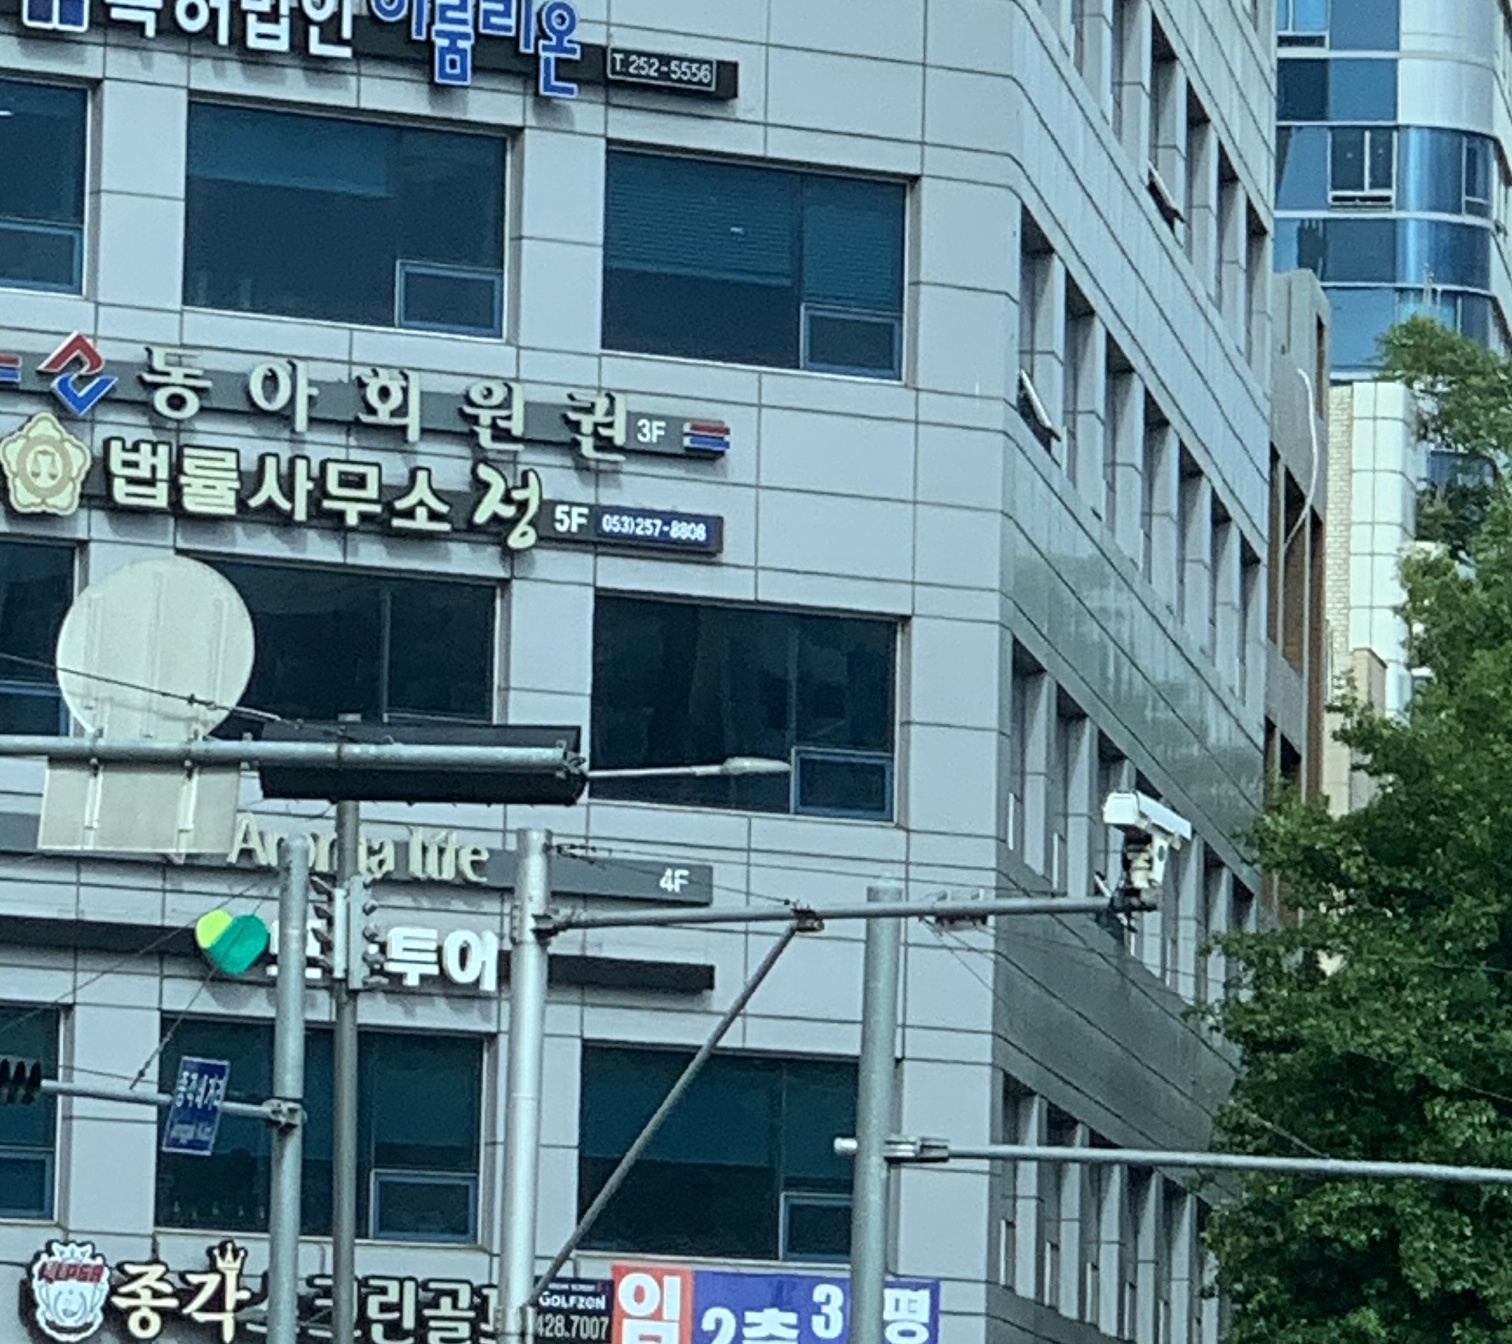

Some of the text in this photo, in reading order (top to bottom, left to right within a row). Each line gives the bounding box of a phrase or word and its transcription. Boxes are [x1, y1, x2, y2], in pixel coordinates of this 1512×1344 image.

[138, 347, 667, 461] 동아회원권 3F
[106, 437, 452, 533] 법률사무소
[554, 505, 589, 533] 5F
[659, 869, 690, 892] 4F
